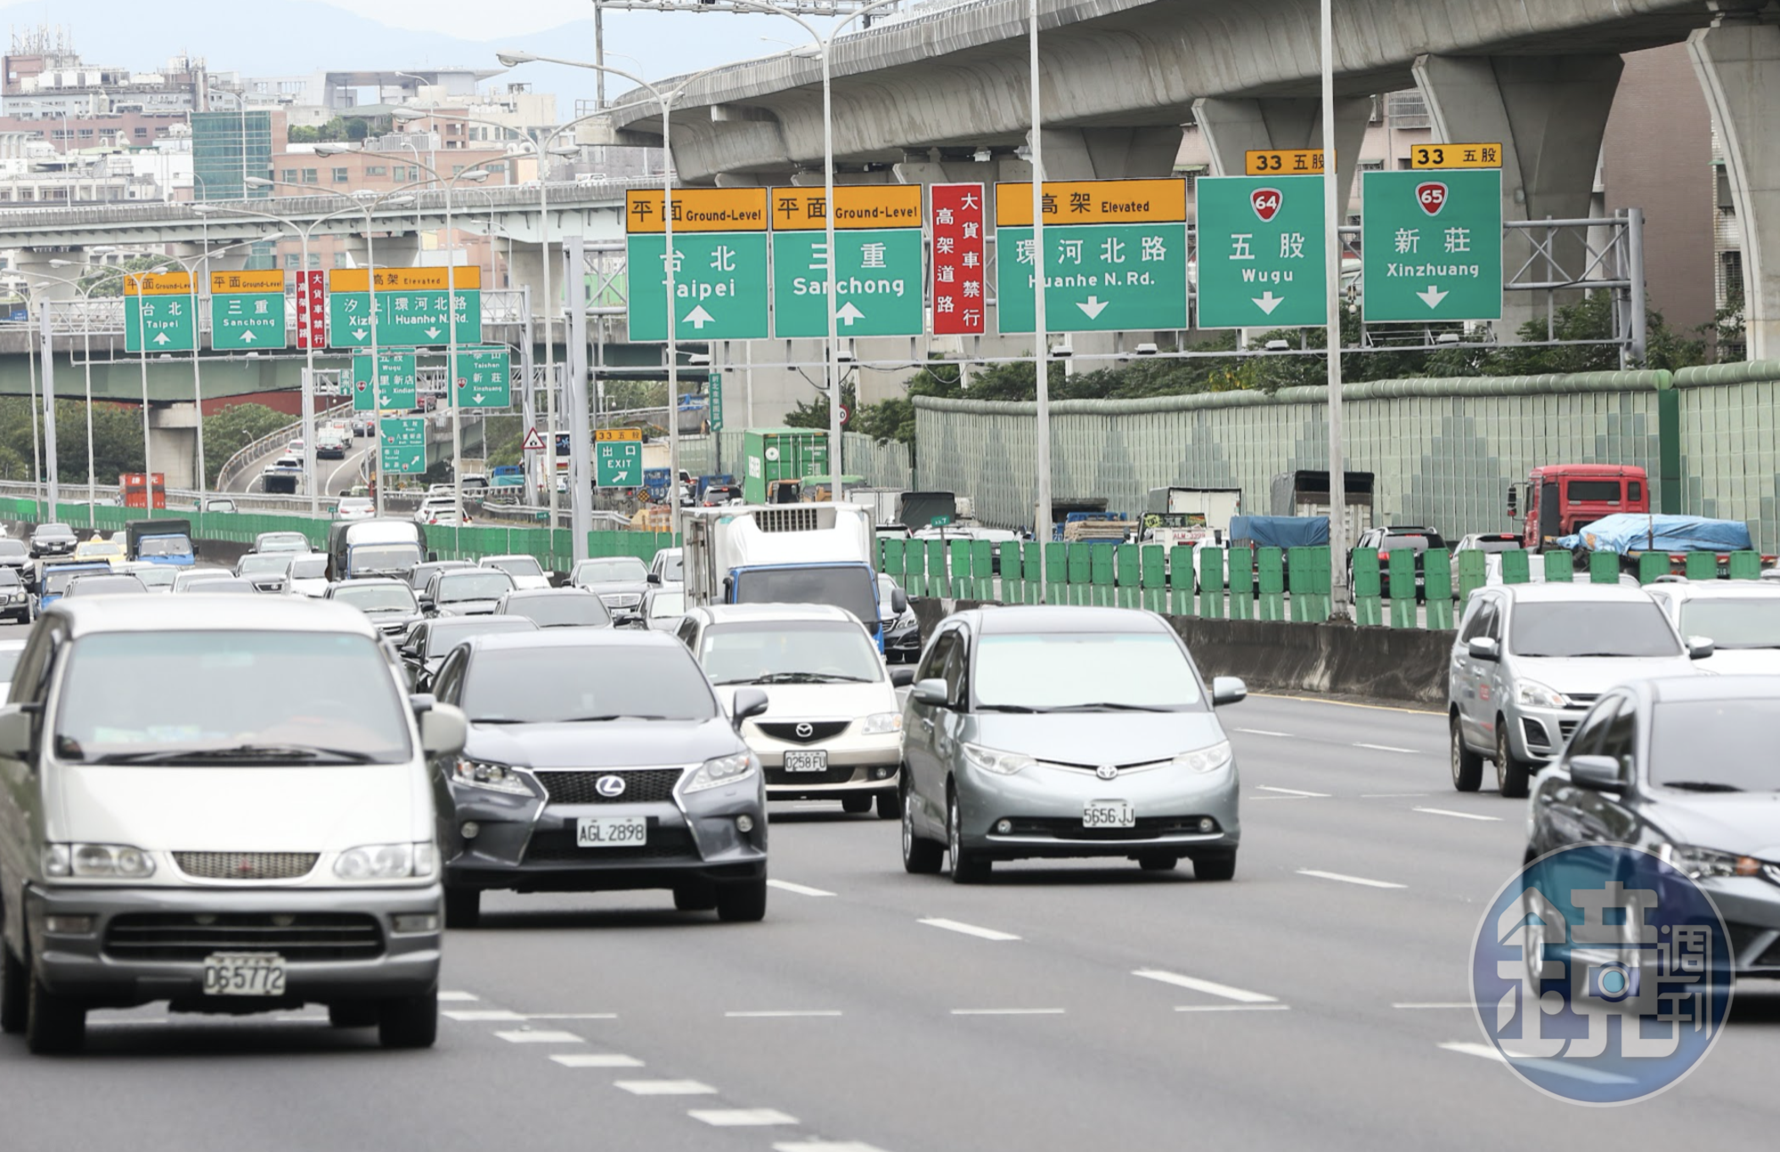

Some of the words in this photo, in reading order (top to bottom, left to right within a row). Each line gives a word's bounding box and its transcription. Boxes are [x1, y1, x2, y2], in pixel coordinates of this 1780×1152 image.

[1256, 155, 1282, 170] 33
[1417, 149, 1444, 164] 33
[1463, 148, 1496, 162] 五股
[1255, 195, 1277, 210] 64
[1421, 189, 1442, 203] 65
[631, 200, 682, 222] 平面
[686, 209, 761, 221] Ground-Level
[778, 197, 826, 219] 平面
[835, 206, 917, 219] Ground-Level
[1102, 201, 1149, 213] Elevated
[1229, 233, 1305, 260] 五股
[1394, 227, 1470, 254] 新莊
[809, 242, 886, 269] 三重
[1016, 235, 1167, 265] 環河北路
[659, 245, 736, 272] 台北
[936, 208, 955, 313] 高架道路
[961, 193, 980, 326] 大貨車禁行
[1242, 269, 1293, 284] Wugu
[1387, 262, 1479, 278] Xinzhuang
[214, 276, 240, 288] 平面
[1105, 272, 1122, 286] N.
[1127, 271, 1155, 286] Rd.
[142, 302, 182, 316] 台北
[228, 299, 268, 314] 三重
[313, 274, 324, 344] 大貨車禁行
[395, 296, 467, 311] 環河北路
[146, 320, 178, 329] Taipei
[223, 318, 275, 327] Sanchong
[396, 314, 436, 324] Huanhe
[602, 446, 636, 457] 出口
[607, 460, 632, 468] EXIT
